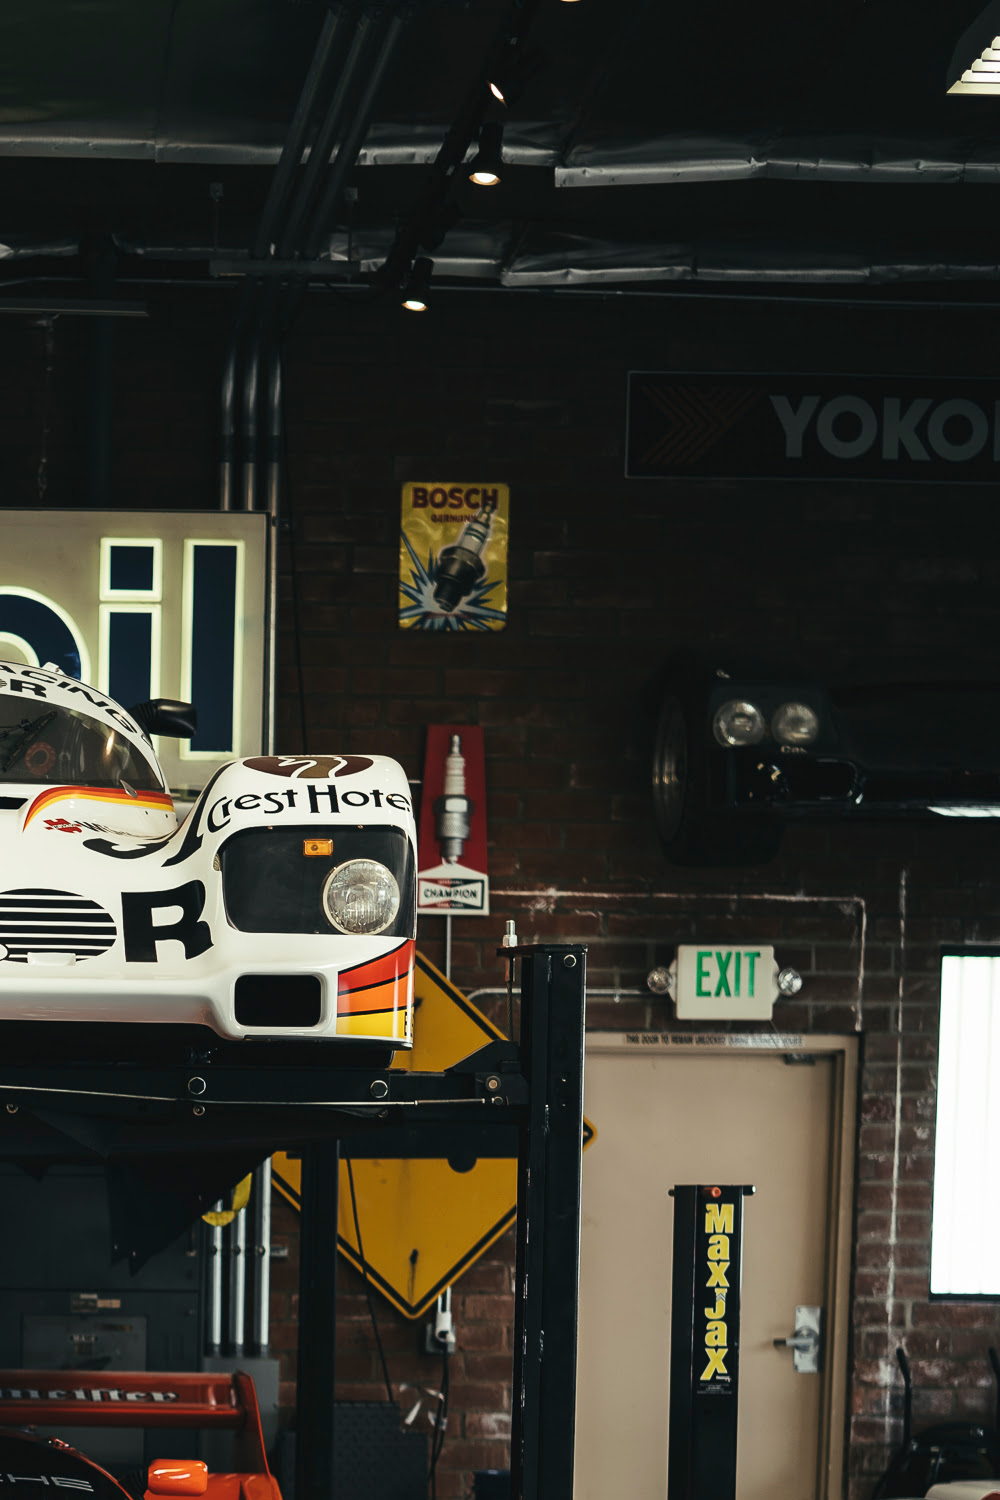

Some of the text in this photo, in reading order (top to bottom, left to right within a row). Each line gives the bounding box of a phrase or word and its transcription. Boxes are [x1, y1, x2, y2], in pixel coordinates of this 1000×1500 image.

[769, 395, 1000, 463] YOKO
[411, 487, 499, 509] BOSCH
[207, 784, 411, 834] Crest Hote
[424, 888, 477, 899] CHAMPION
[696, 951, 761, 997] EXIT
[641, 1034, 659, 1045] DOOR
[661, 1034, 669, 1045] TO
